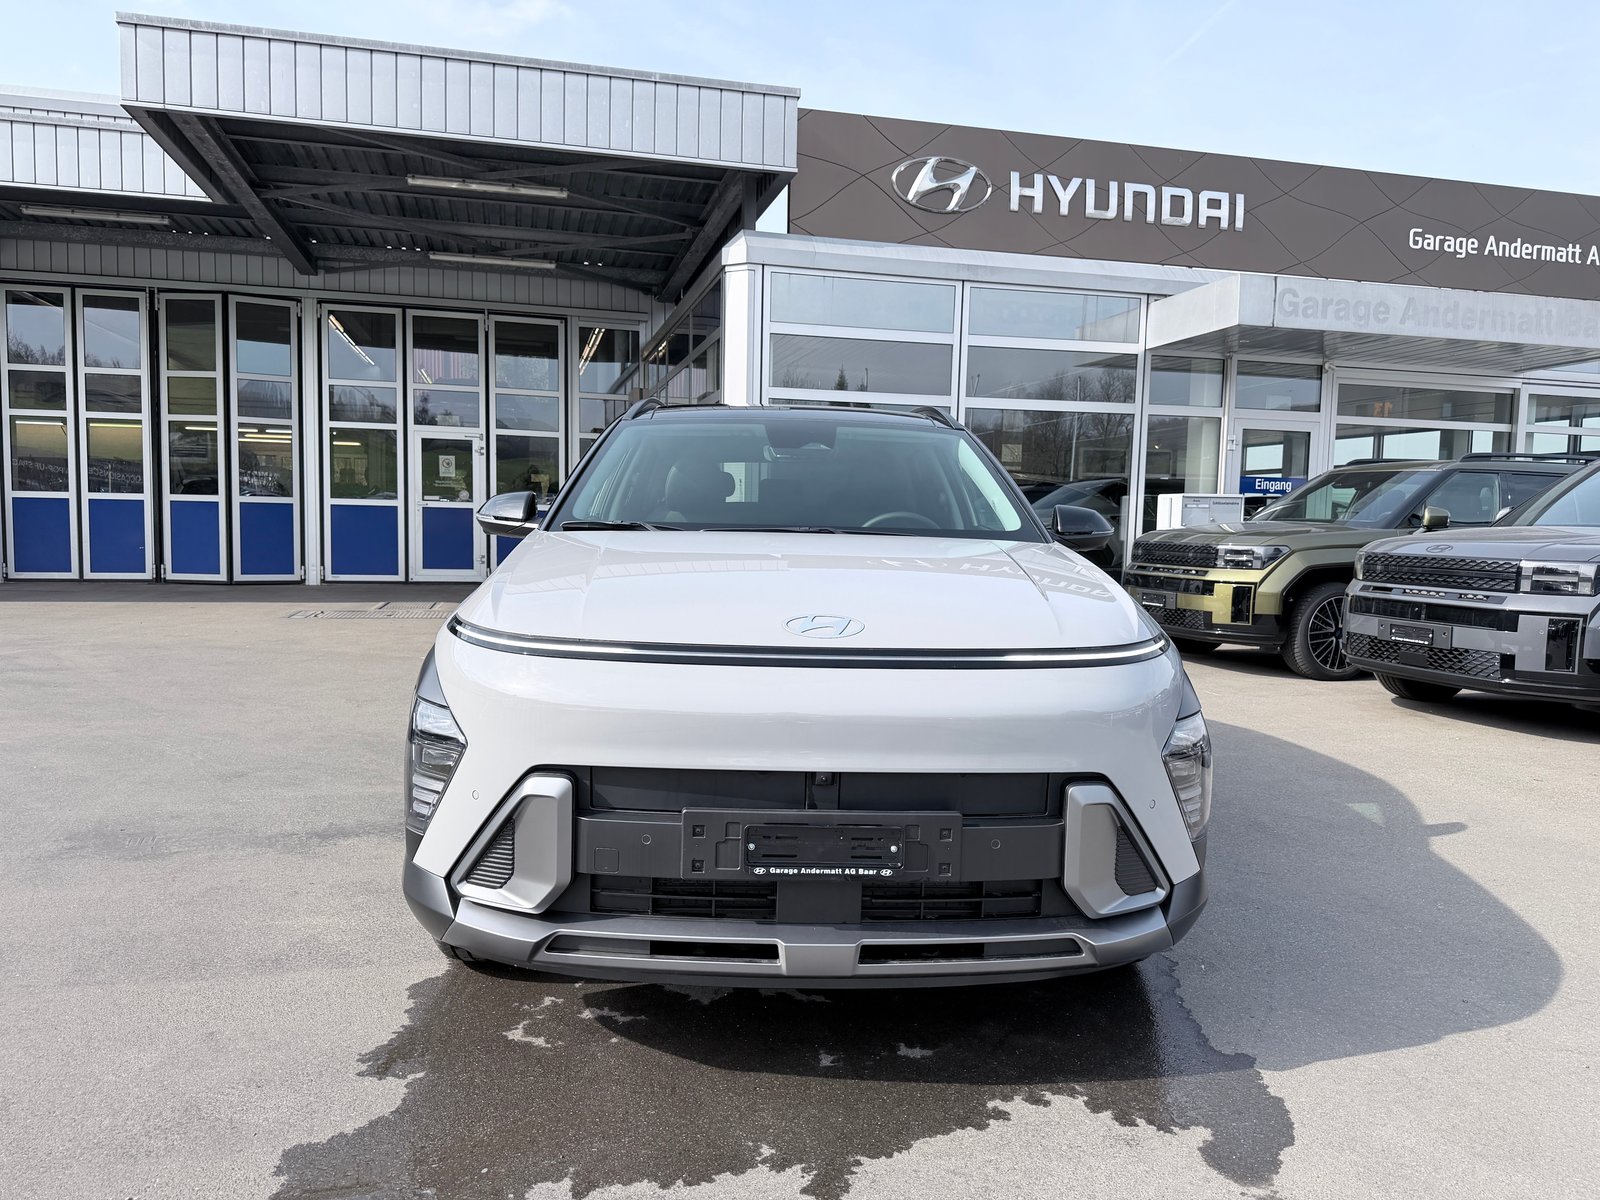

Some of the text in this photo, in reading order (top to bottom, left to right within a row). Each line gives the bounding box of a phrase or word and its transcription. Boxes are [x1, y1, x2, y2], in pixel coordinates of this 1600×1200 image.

[1010, 171, 1245, 231] HYUNDAI
[1409, 228, 1479, 259] Garage
[1484, 235, 1582, 264] Andermatt
[1277, 287, 1391, 326] Garage
[1400, 297, 1554, 336] Andermatt
[1255, 478, 1292, 492] Eingang
